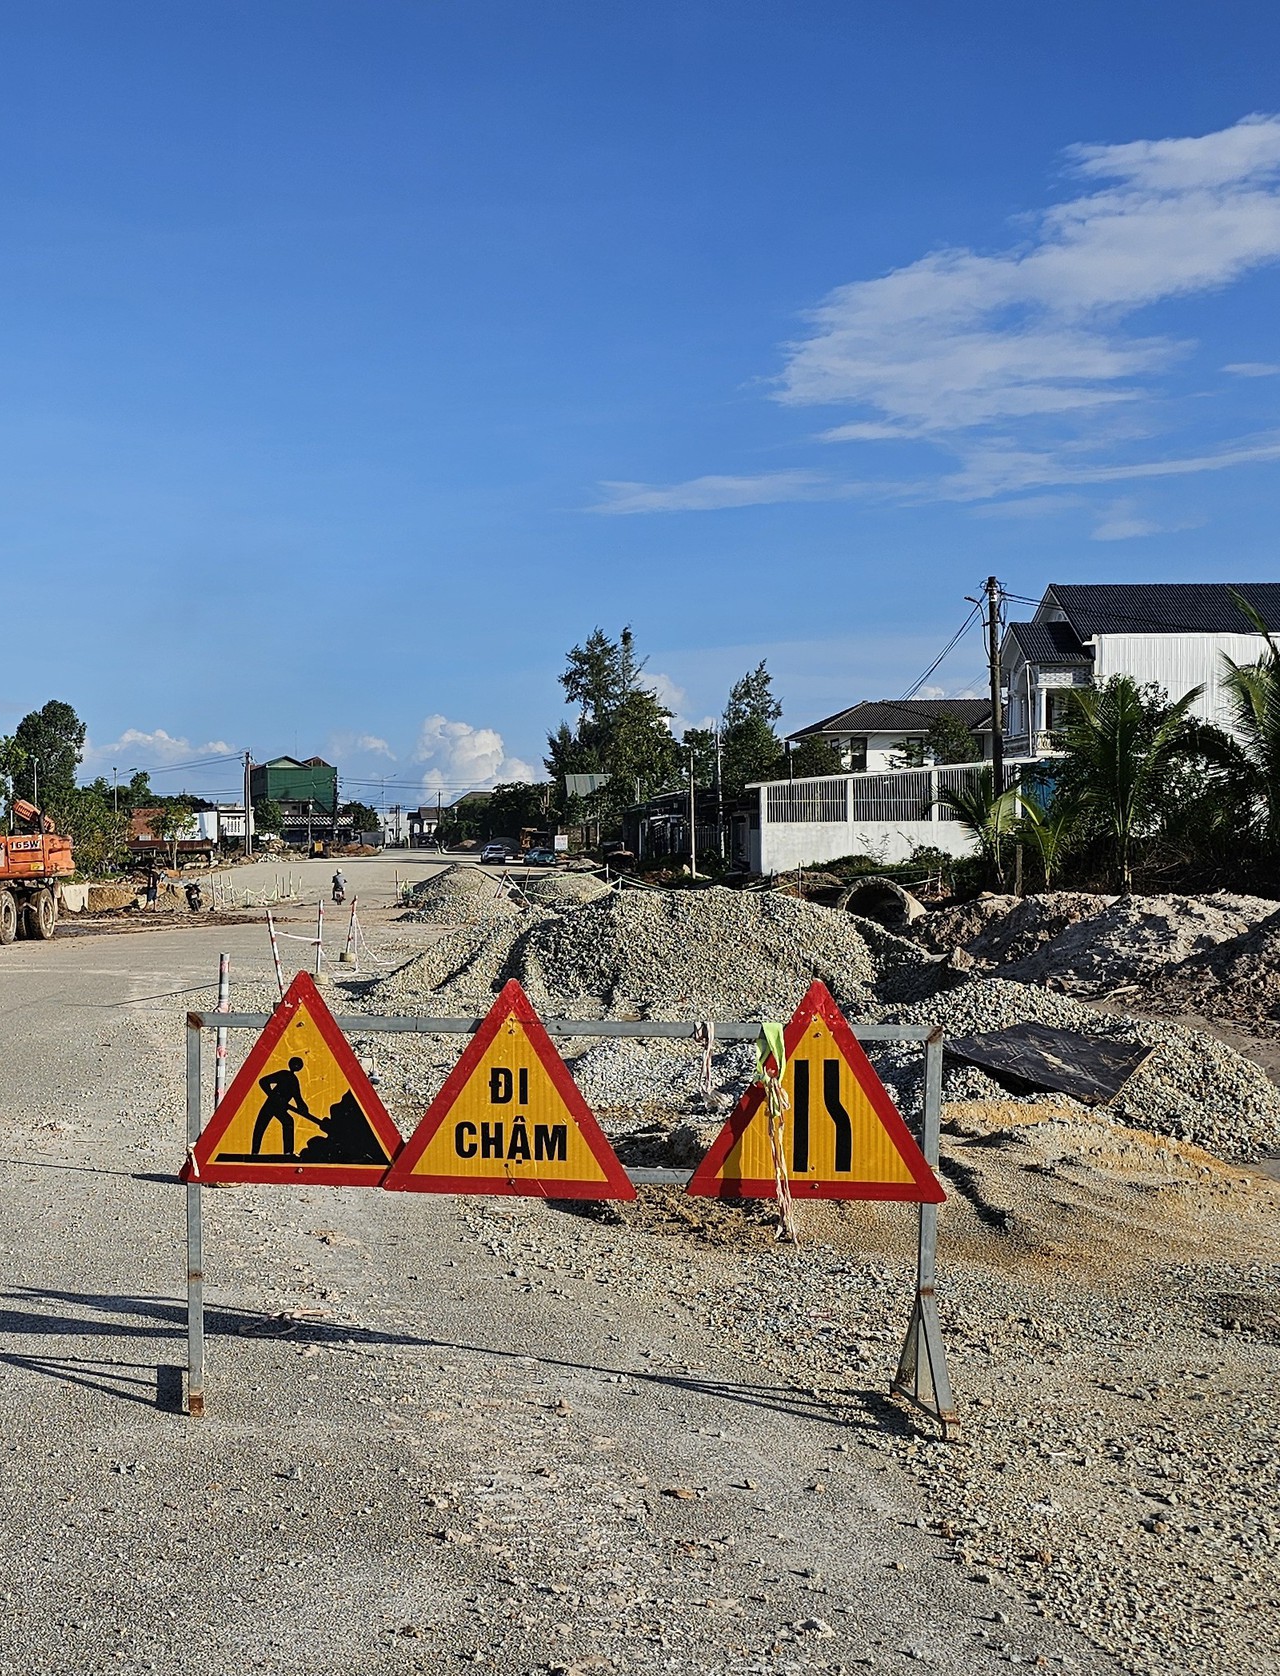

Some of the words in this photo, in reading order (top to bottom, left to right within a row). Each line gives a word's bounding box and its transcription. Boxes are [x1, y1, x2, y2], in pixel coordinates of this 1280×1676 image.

[9, 840, 39, 850] 165W
[488, 1067, 529, 1105] ĐI
[454, 1115, 568, 1165] CHẬM
